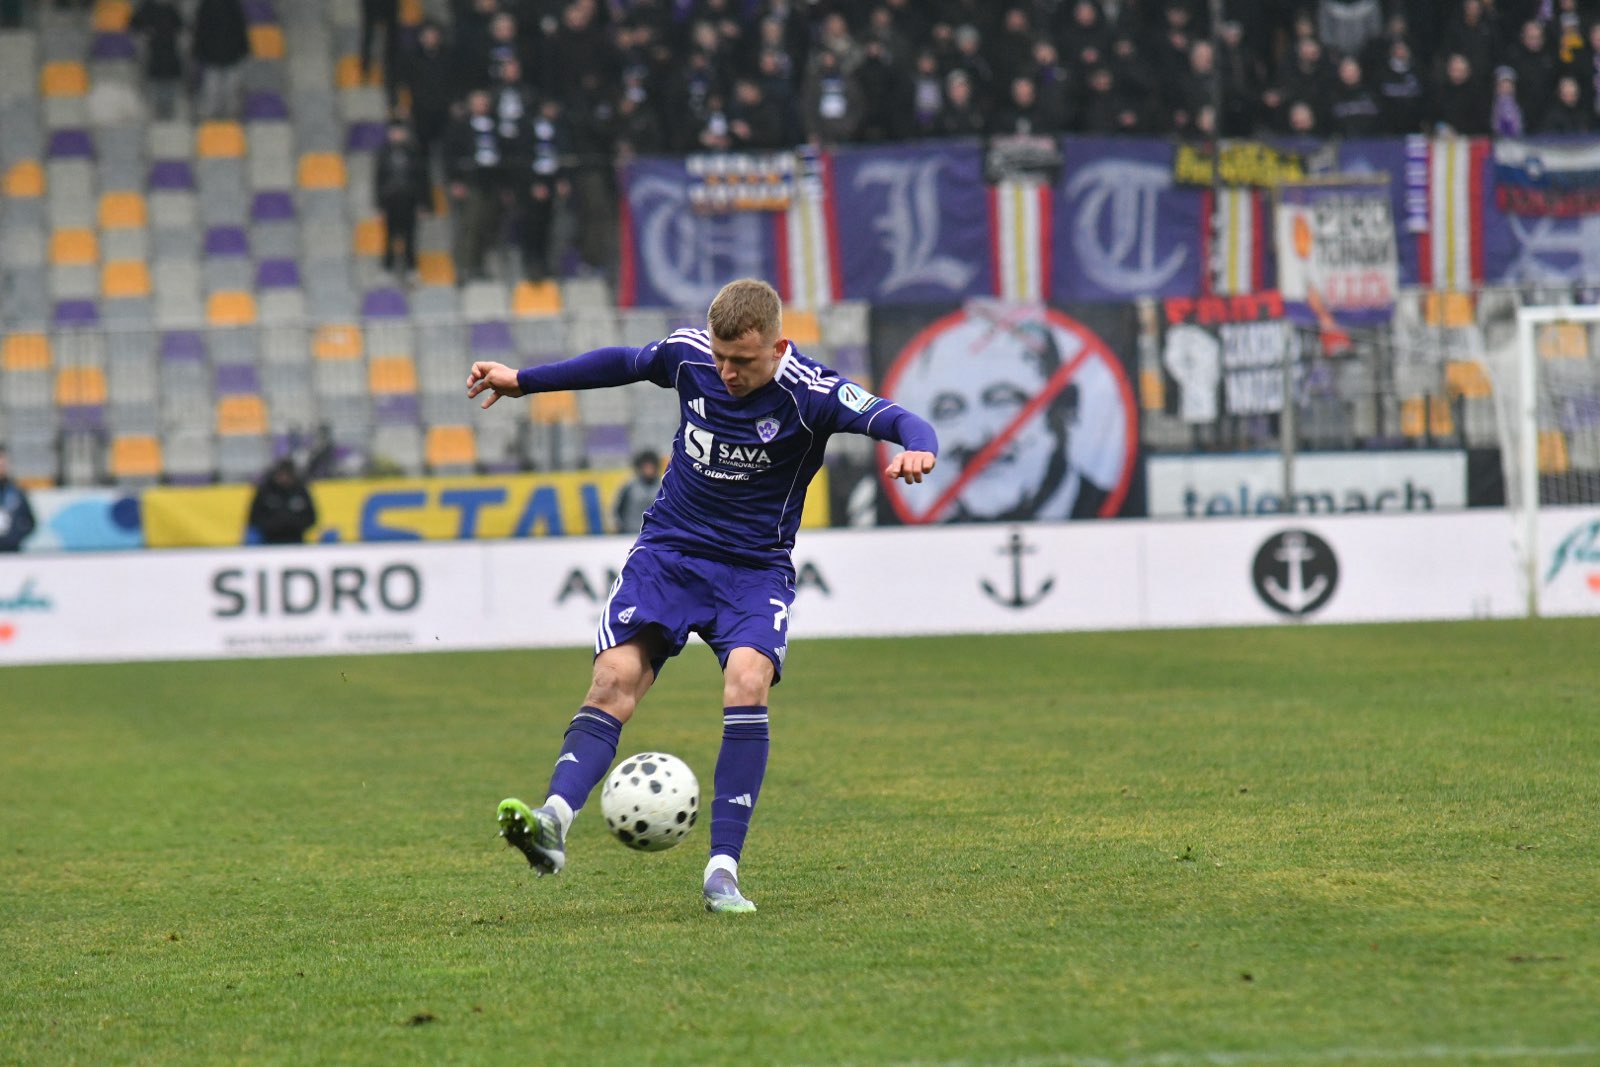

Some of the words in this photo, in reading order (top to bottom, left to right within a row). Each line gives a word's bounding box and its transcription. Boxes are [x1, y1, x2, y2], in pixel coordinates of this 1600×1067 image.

[719, 443, 772, 464] SAVA
[1184, 480, 1434, 517] telemach
[212, 564, 422, 618] SIDRO
[769, 598, 788, 632] 7
